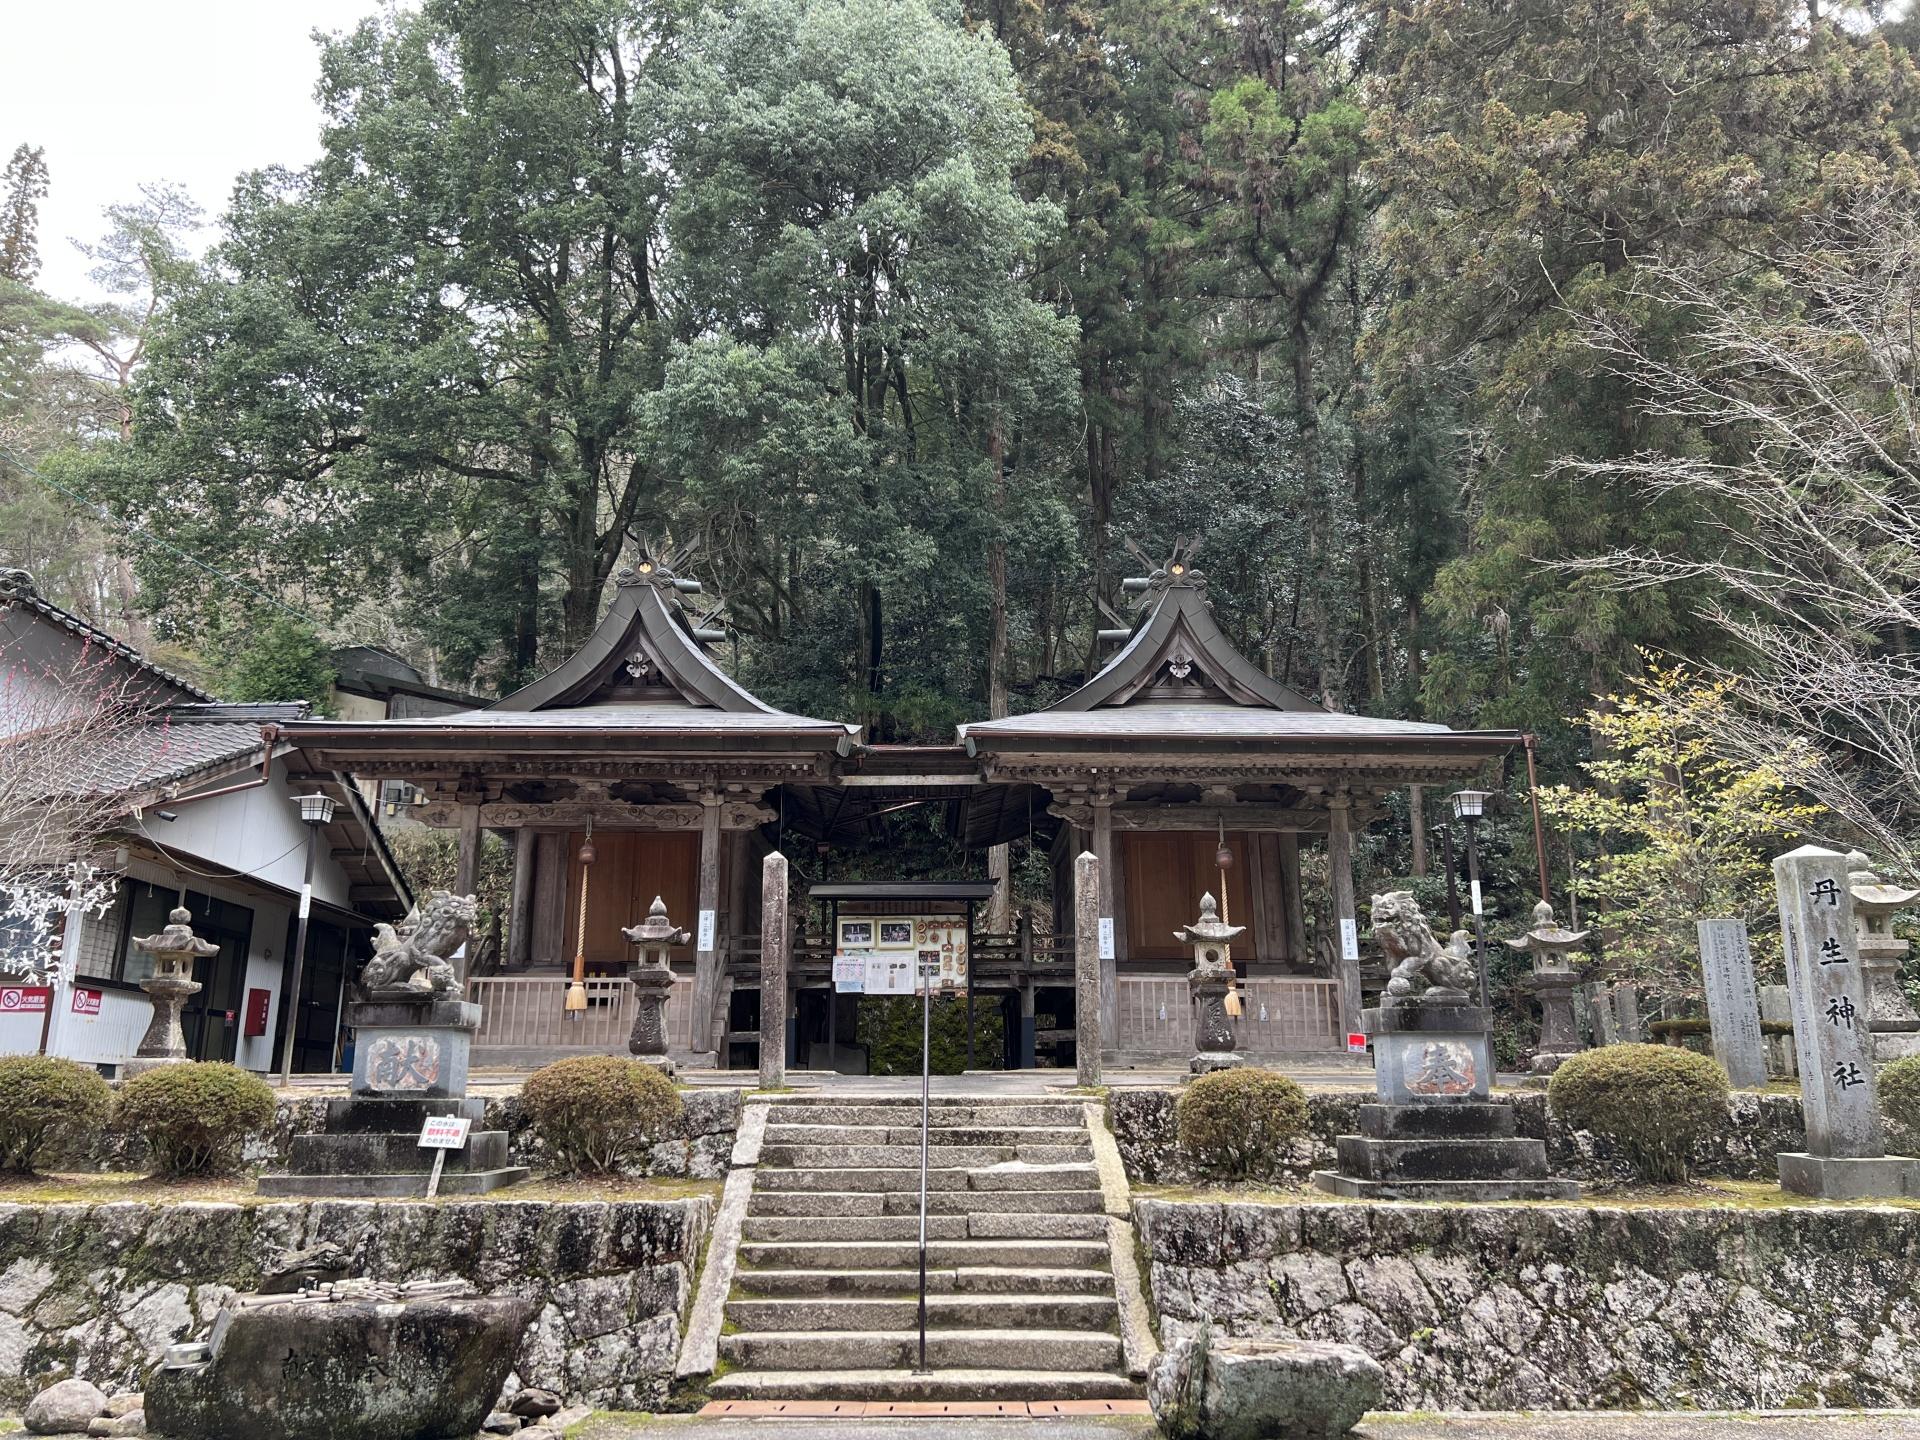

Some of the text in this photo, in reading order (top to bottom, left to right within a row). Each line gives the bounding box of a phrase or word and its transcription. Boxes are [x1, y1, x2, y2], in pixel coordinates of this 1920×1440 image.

[1809, 878, 1866, 1091] 丹生神社
[376, 1039, 430, 1086] 献
[1416, 1043, 1469, 1093] 奉
